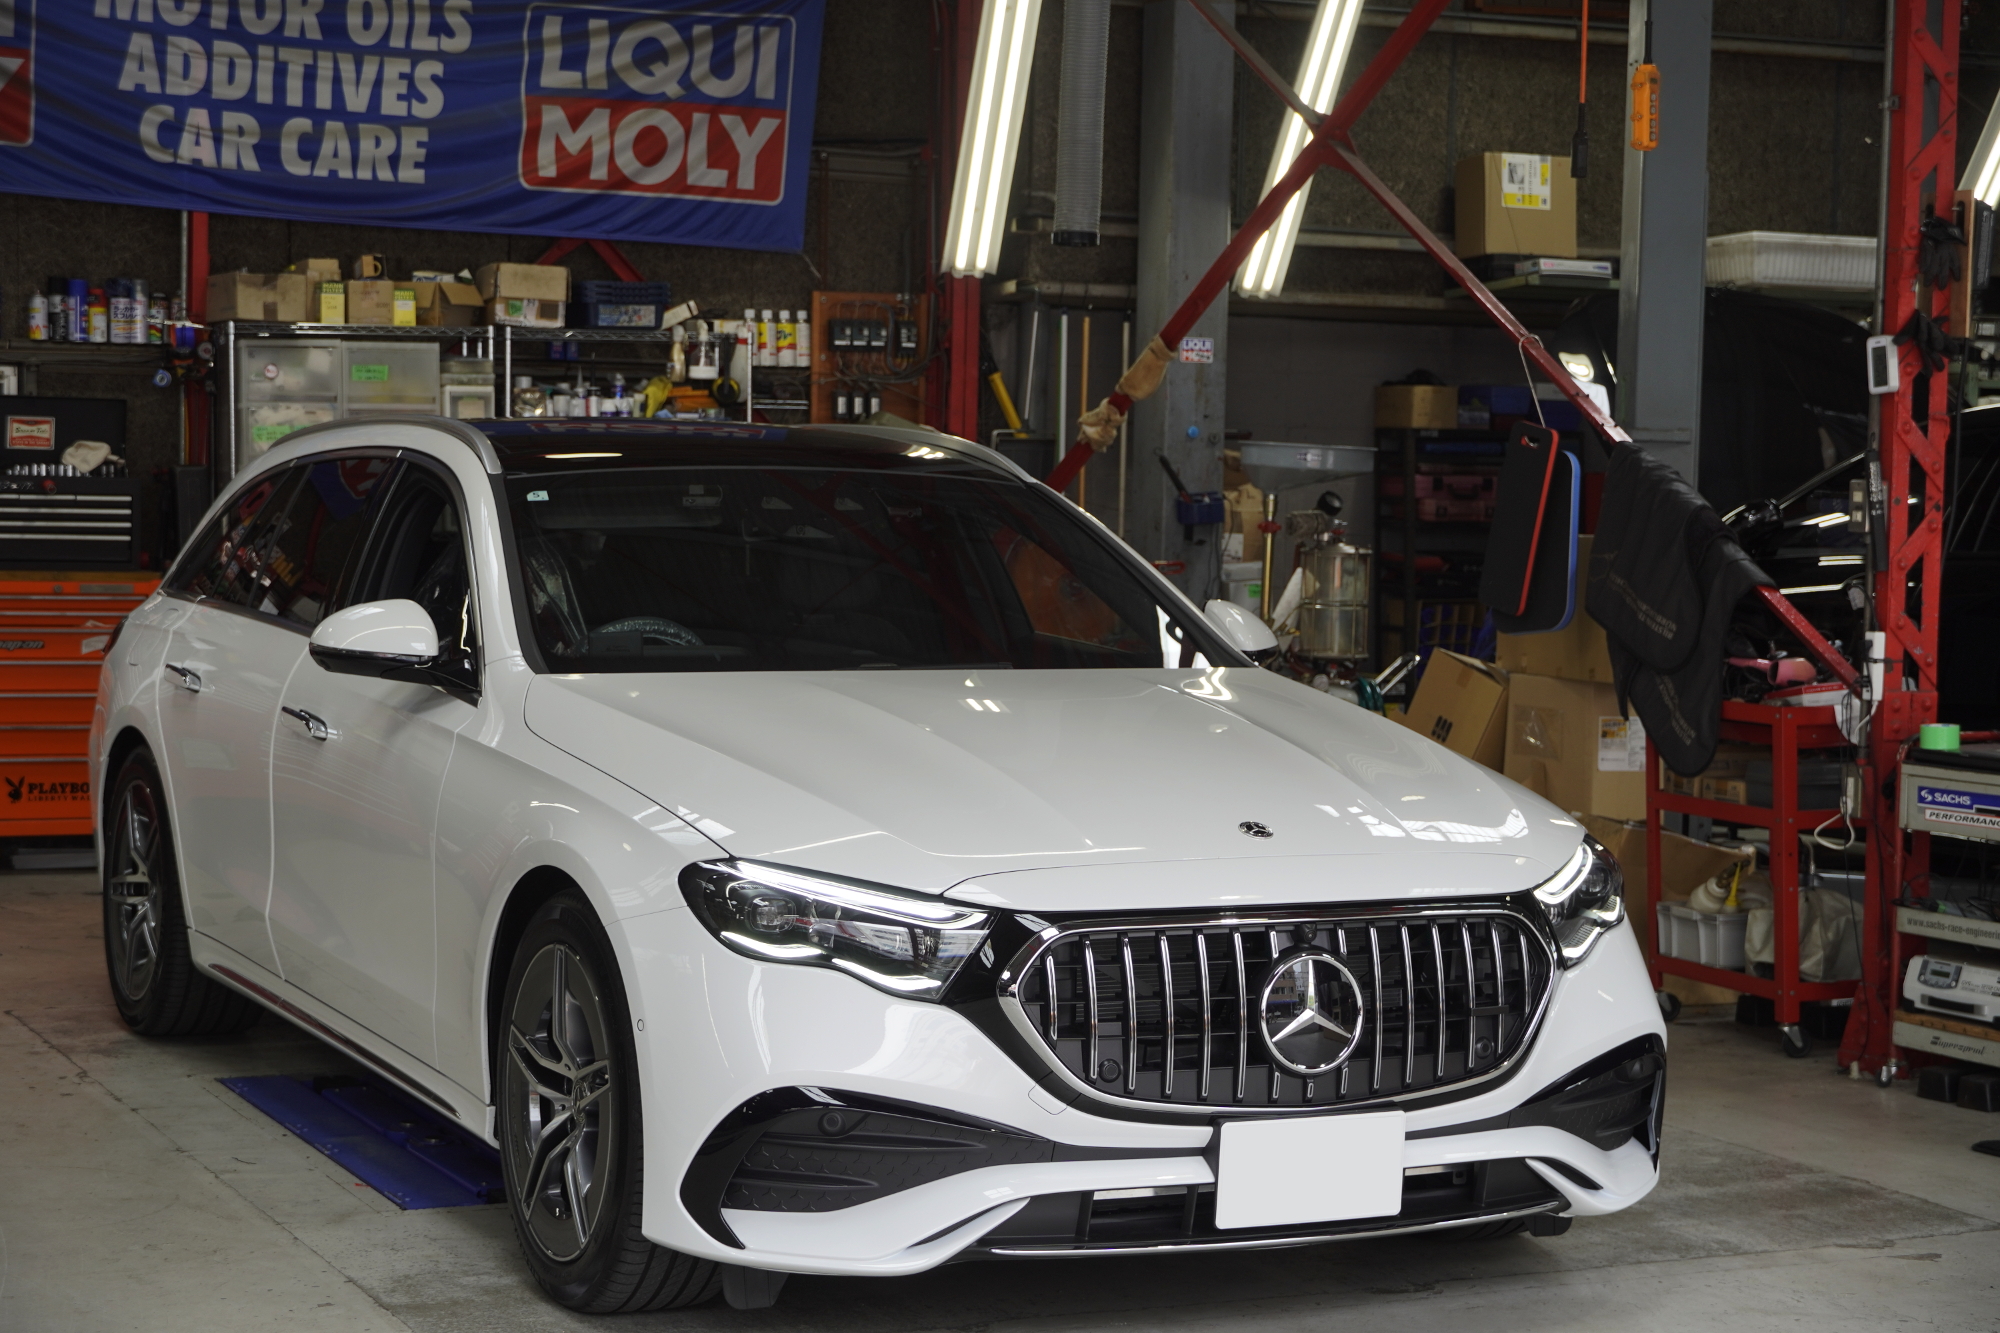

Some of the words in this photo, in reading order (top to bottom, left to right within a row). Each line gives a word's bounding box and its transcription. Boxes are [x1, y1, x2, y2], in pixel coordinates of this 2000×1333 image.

[346, 0, 474, 54] OILS
[538, 16, 781, 101] LIQUI
[118, 32, 445, 119] ADDITIVES
[139, 105, 261, 172] CAR
[280, 118, 426, 185] CARE
[537, 105, 782, 191] MOLY
[28, 782, 90, 794] PLAYBO
[1933, 791, 1972, 806] SACHS
[1929, 1035, 1986, 1056] Supersprint
